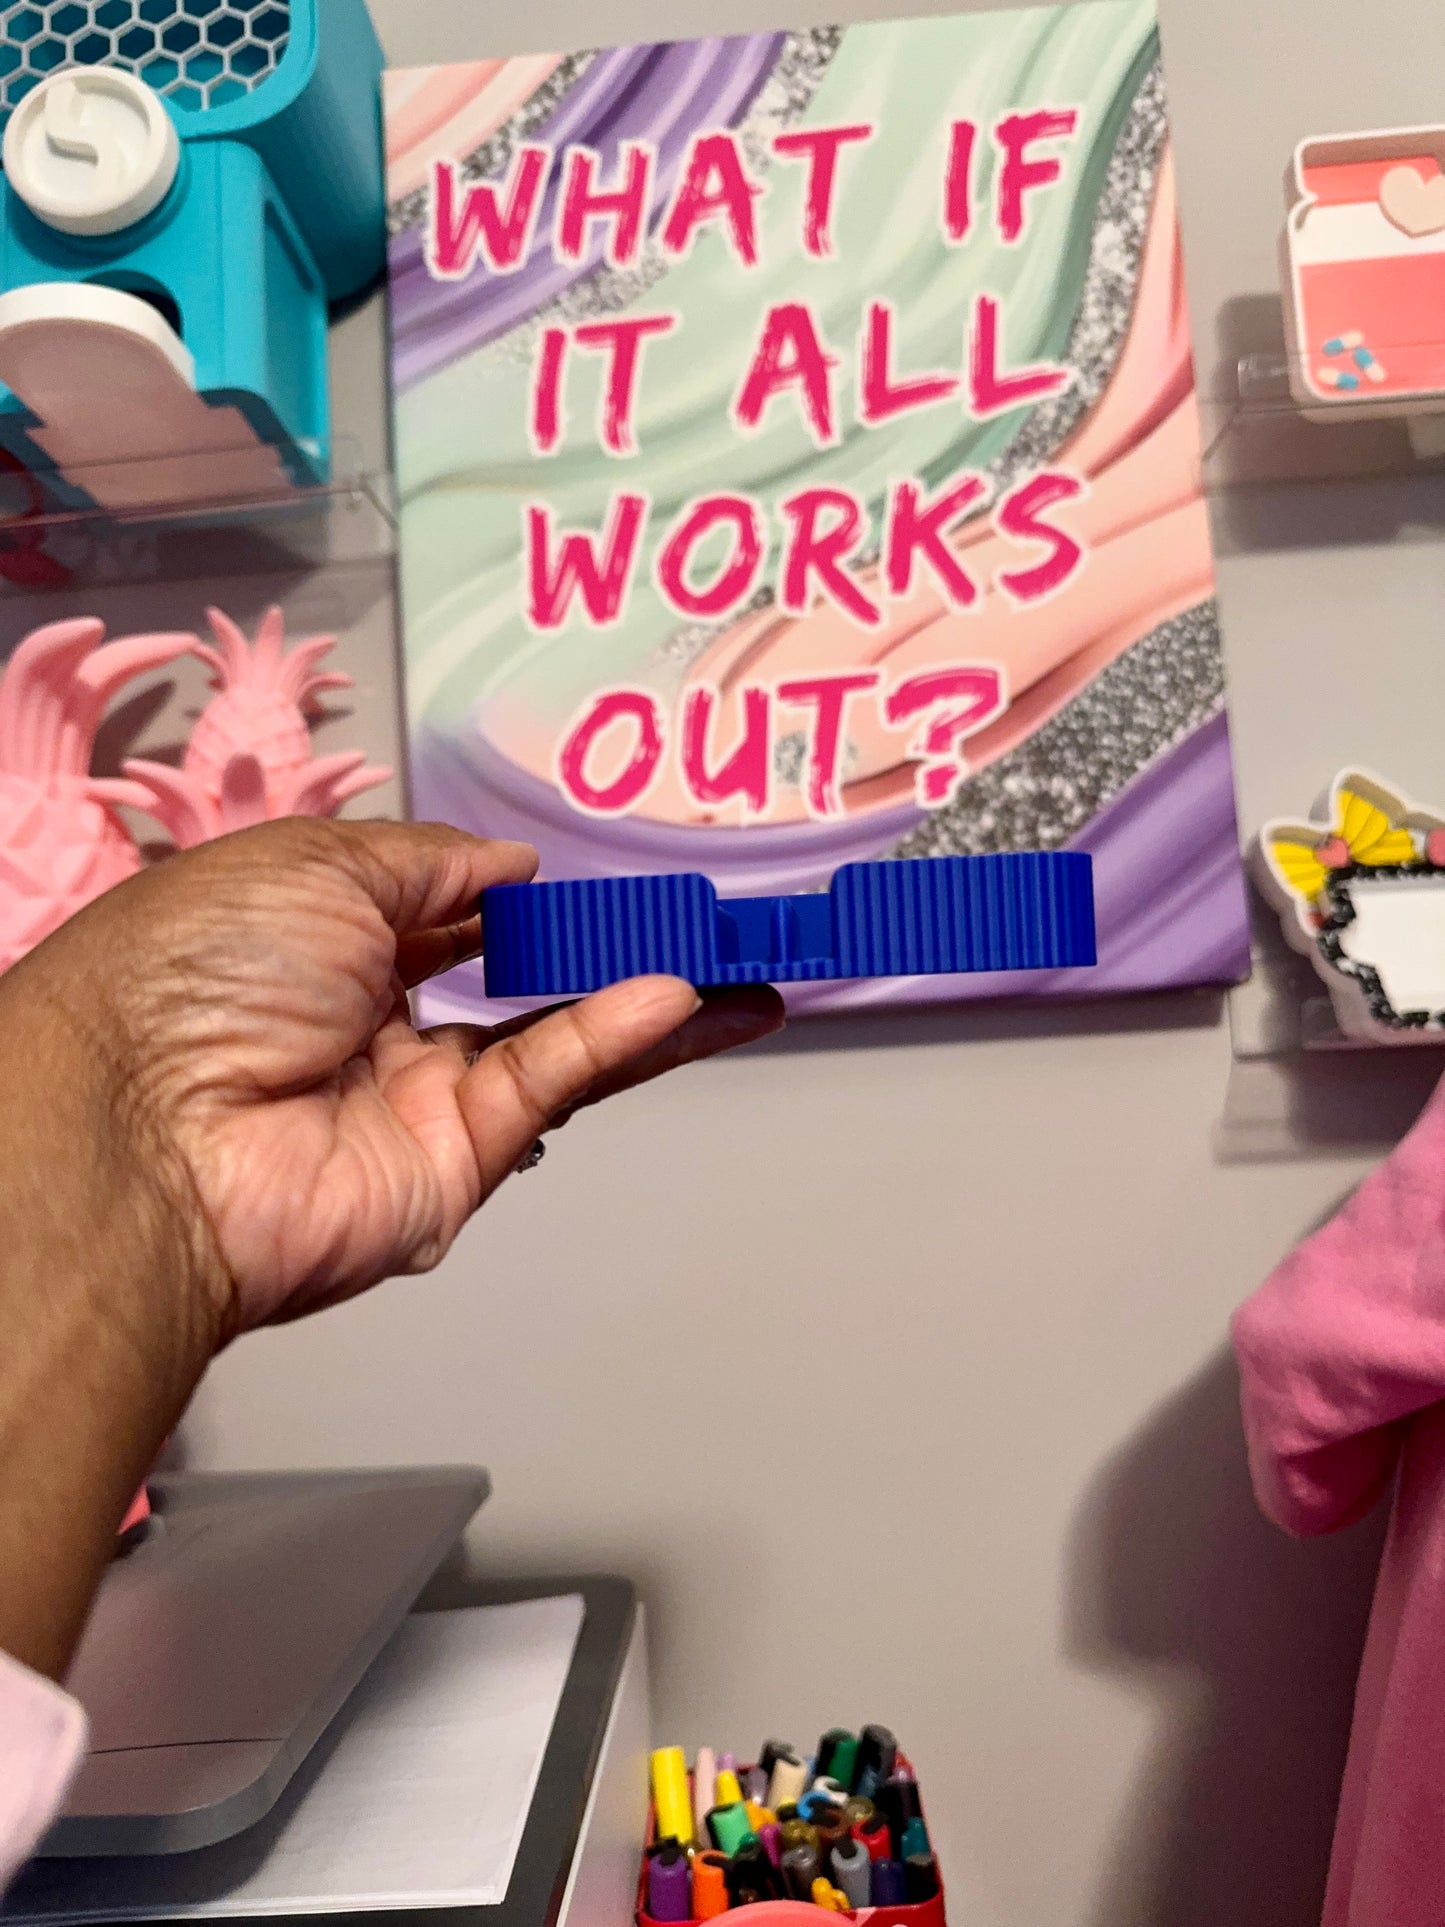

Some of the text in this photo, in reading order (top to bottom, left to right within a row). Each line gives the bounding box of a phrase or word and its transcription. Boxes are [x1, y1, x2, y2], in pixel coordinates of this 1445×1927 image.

[432, 110, 1078, 274] WHAT IF
[532, 296, 1067, 451] IT ALL
[528, 473, 1082, 627] WORKS
[559, 668, 1001, 814] OUT?
